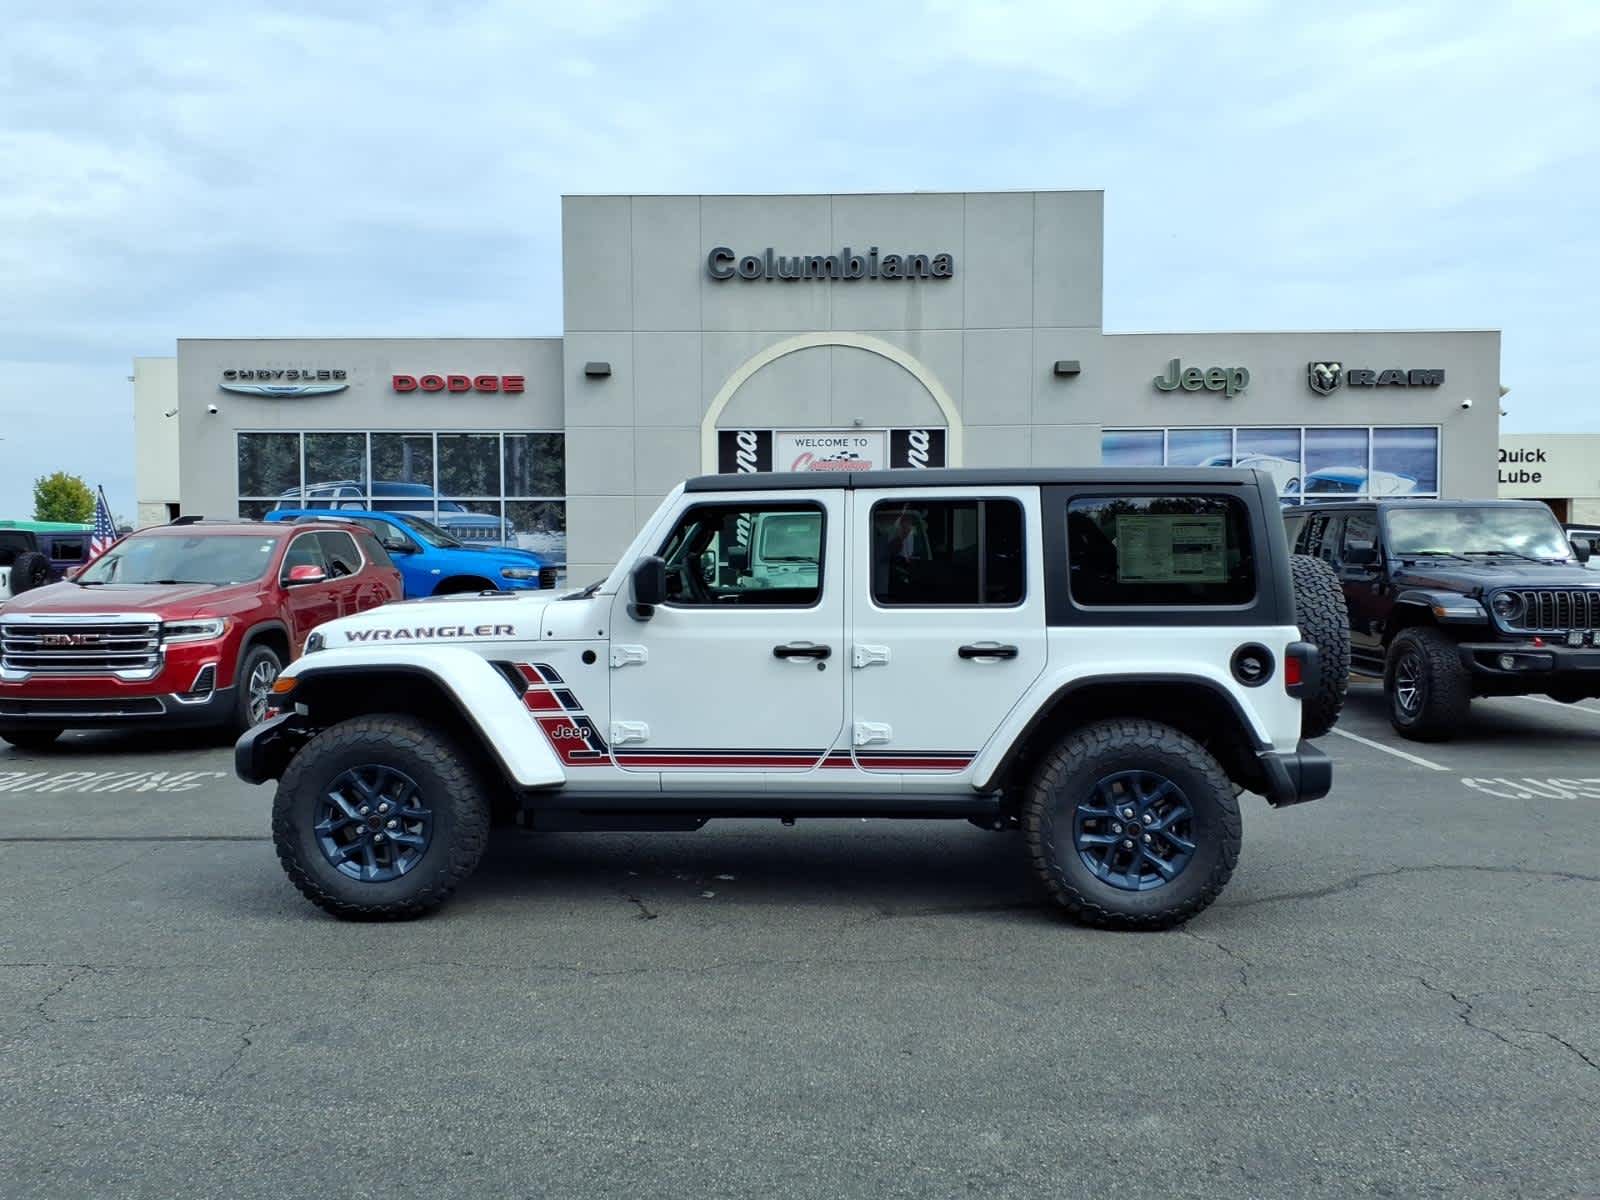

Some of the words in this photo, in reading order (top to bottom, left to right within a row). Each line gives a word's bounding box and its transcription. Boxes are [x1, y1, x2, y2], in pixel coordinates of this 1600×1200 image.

[707, 247, 953, 282] Columbiana
[223, 369, 348, 381] CHRYSLER
[1152, 358, 1251, 398] Jeep
[1348, 369, 1446, 388] RAM
[392, 375, 525, 393] DODGE
[795, 438, 849, 447] WELCOME
[853, 438, 868, 447] TO
[1498, 448, 1547, 463] Quick
[1497, 469, 1542, 483] Lube
[42, 634, 100, 646] GMC
[344, 624, 516, 642] WRANGLER
[552, 724, 592, 740] Jeep
